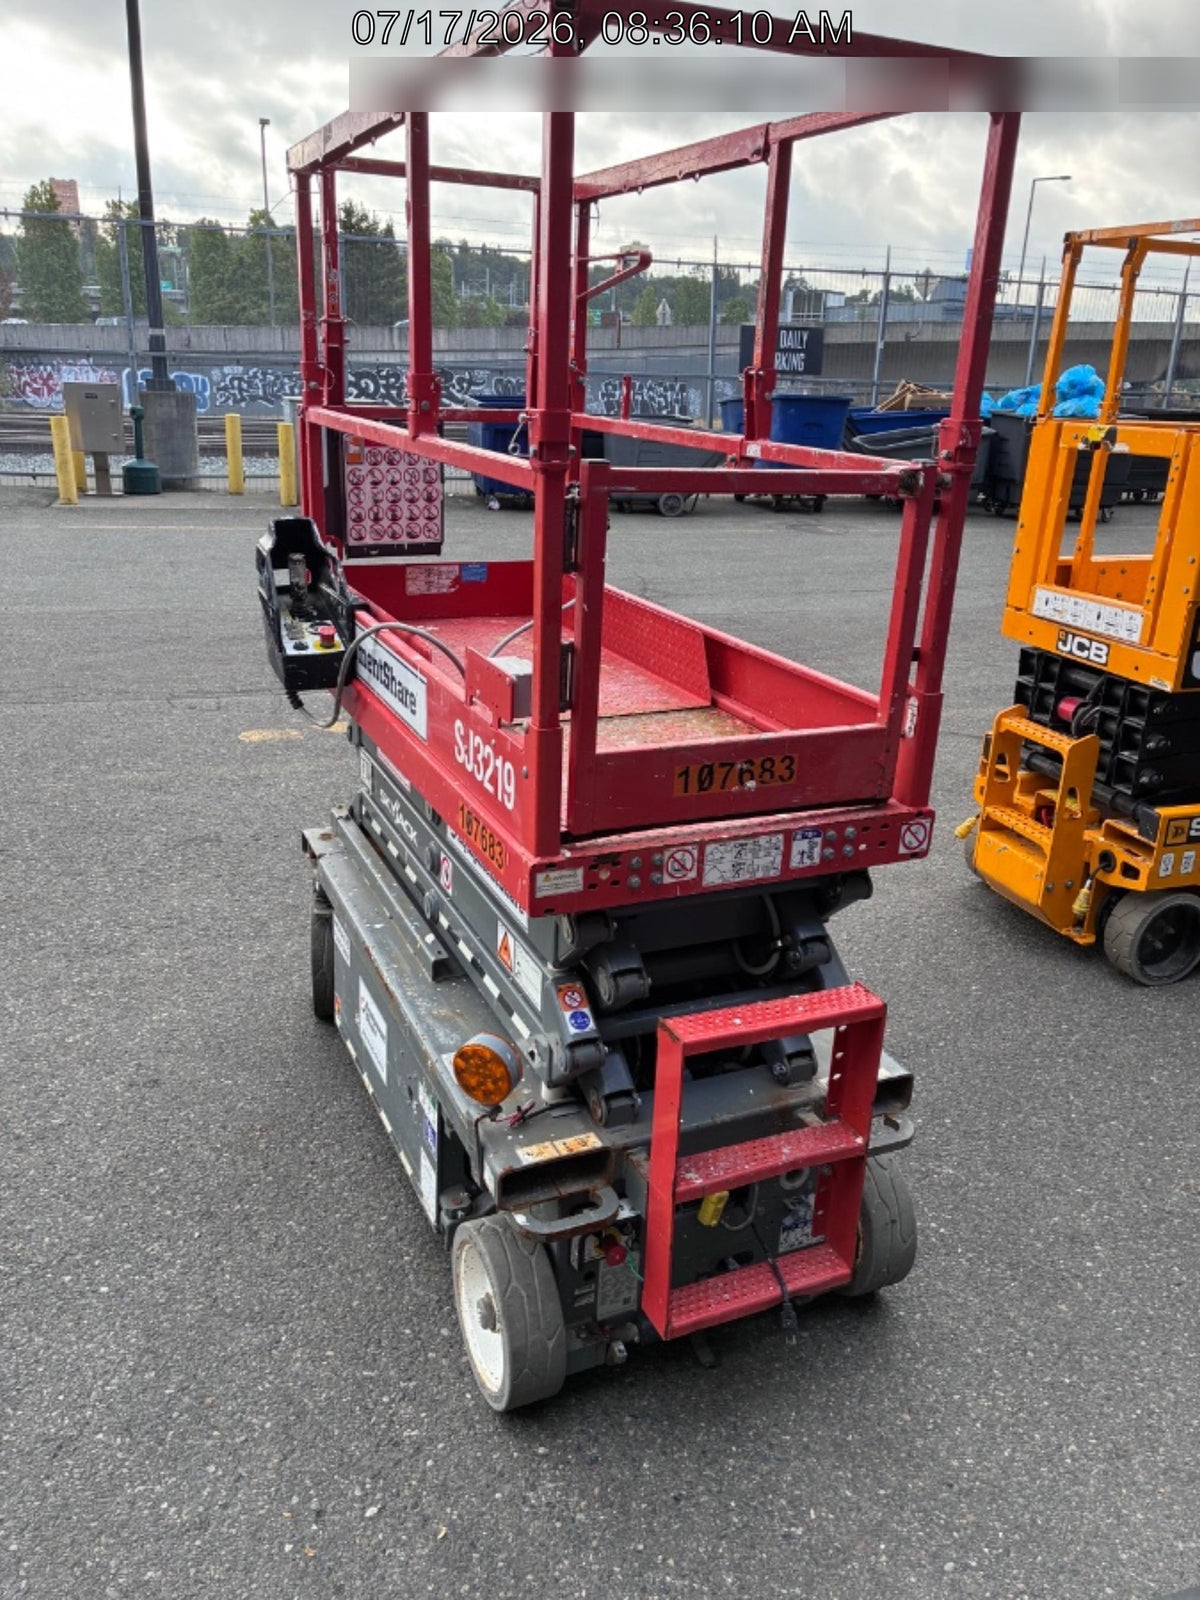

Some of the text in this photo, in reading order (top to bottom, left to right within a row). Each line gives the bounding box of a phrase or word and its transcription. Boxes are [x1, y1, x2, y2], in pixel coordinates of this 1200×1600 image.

[779, 329, 809, 350] DAILY
[774, 351, 806, 372] RKING
[1057, 632, 1110, 666] JCB
[357, 645, 418, 716] mentShare
[453, 718, 516, 811] SJ3219
[677, 754, 796, 794] 107683
[458, 802, 505, 871] 107683
